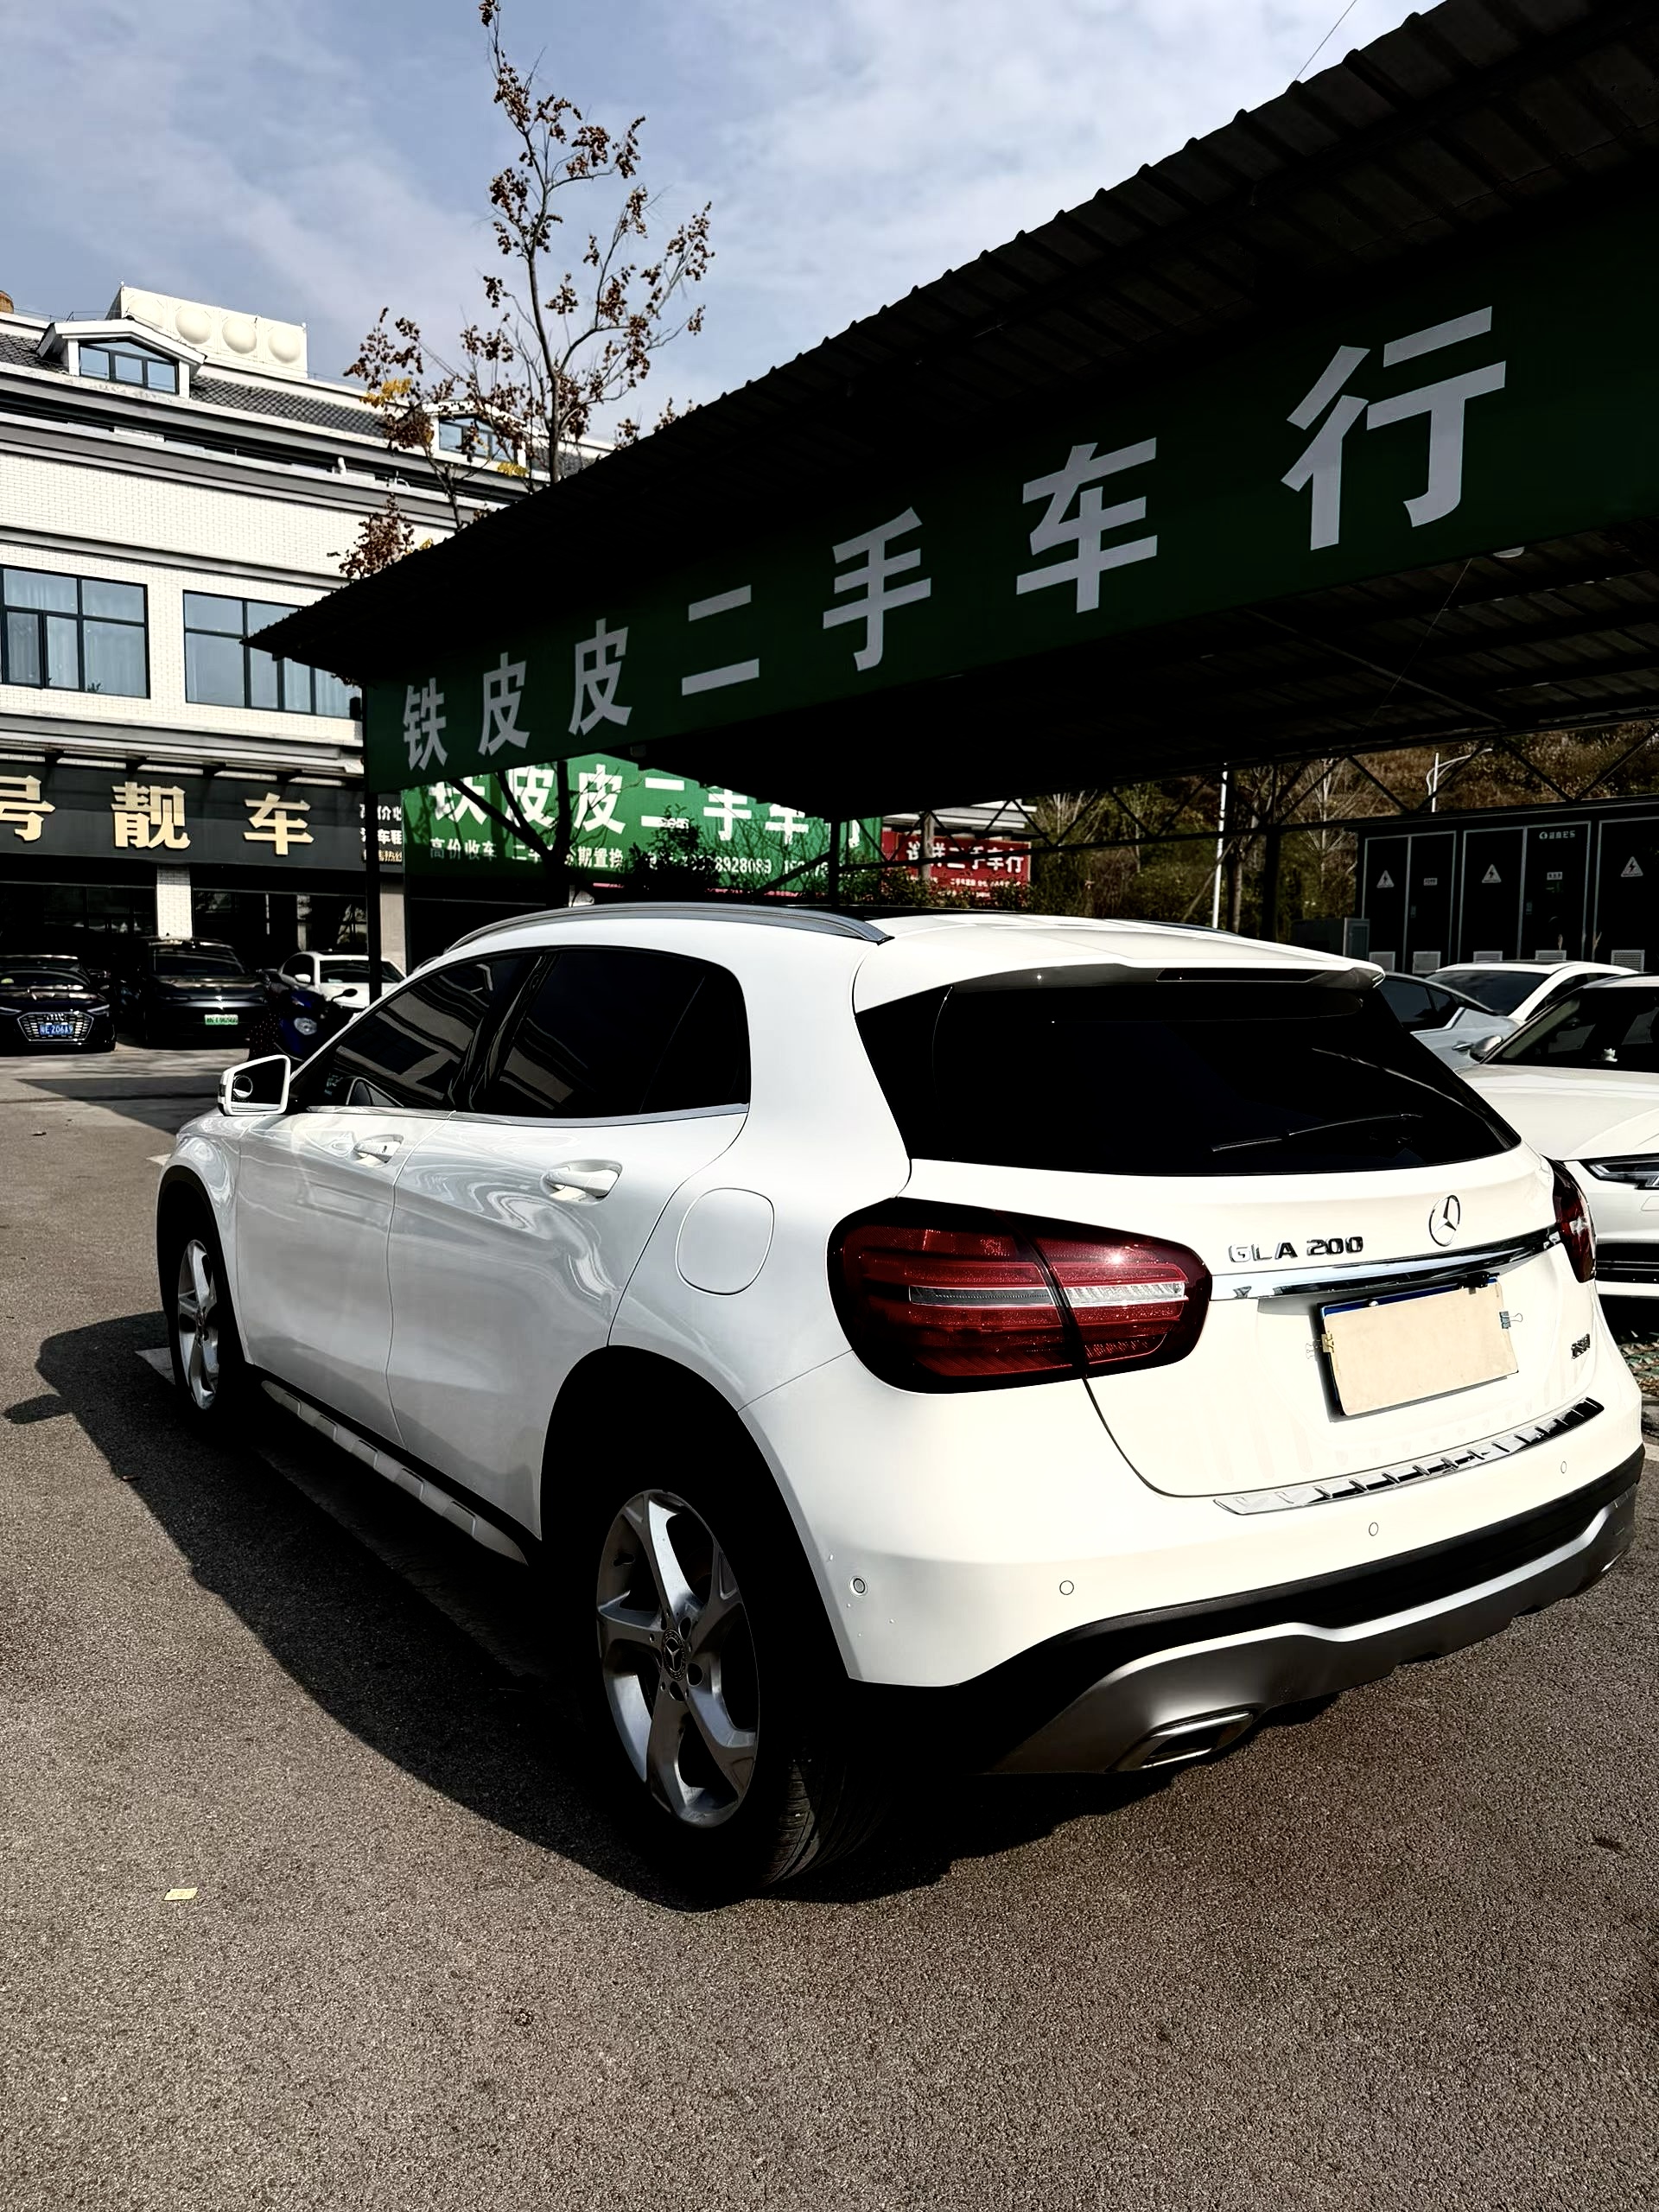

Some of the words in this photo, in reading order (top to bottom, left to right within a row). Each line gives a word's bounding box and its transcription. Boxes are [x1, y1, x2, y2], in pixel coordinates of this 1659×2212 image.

[403, 306, 1506, 771] 铁皮皮二手车行
[0, 774, 315, 855] 号靓车
[430, 837, 497, 861] 高价收车
[1228, 1242, 1298, 1263] GLA
[1306, 1236, 1363, 1256] 200
